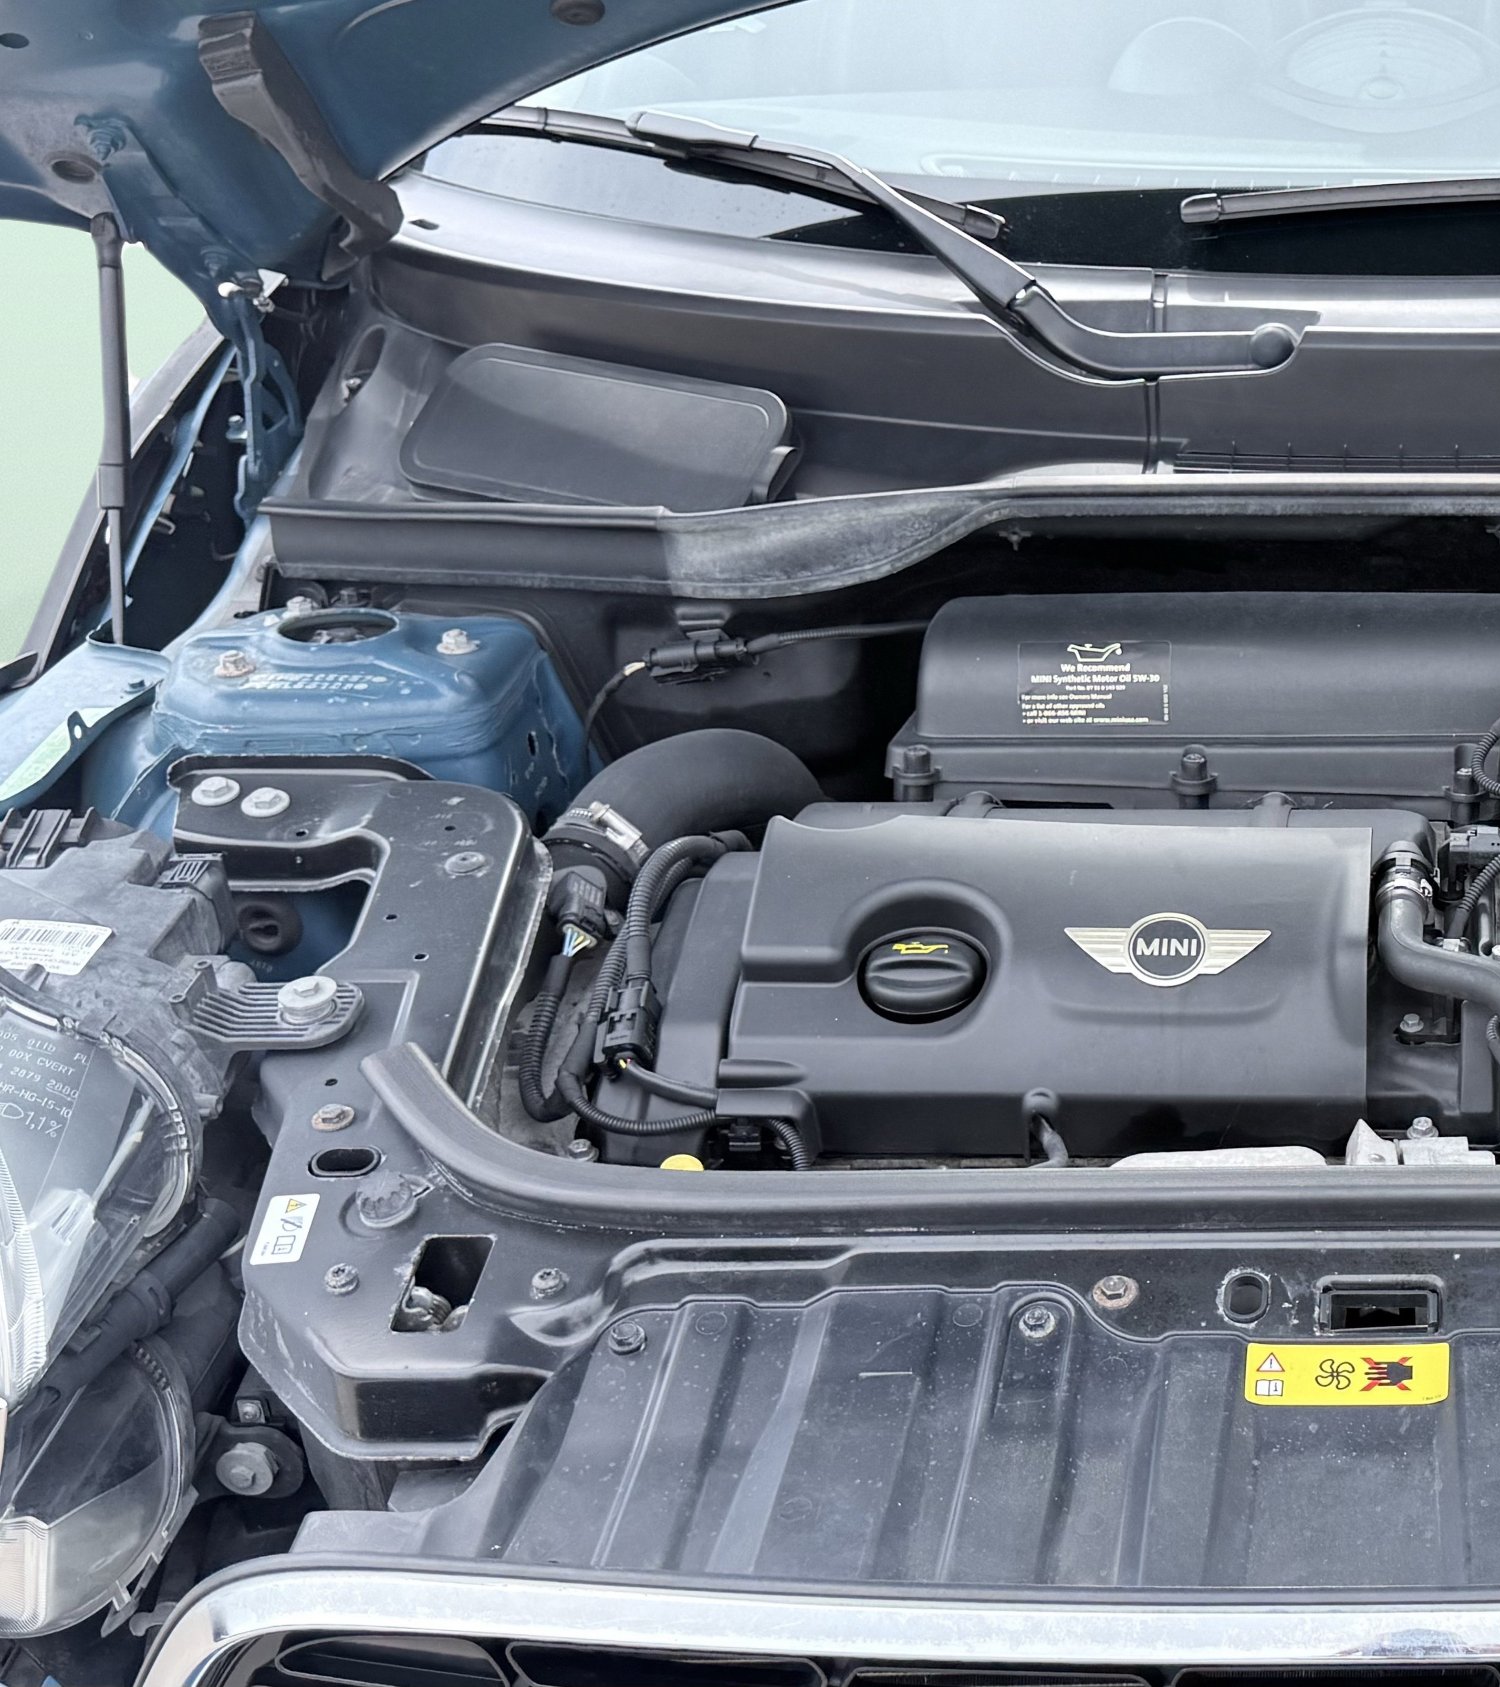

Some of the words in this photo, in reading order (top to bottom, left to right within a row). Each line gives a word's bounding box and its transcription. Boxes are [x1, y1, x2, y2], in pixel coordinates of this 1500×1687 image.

[1061, 663, 1076, 673] We
[1077, 662, 1131, 673] Recommend
[1053, 674, 1091, 686] Synthetic
[1092, 674, 1118, 683] Motor
[1119, 673, 1132, 683] Oil
[1132, 673, 1161, 683] 5W-30
[1136, 938, 1198, 957] MINI
